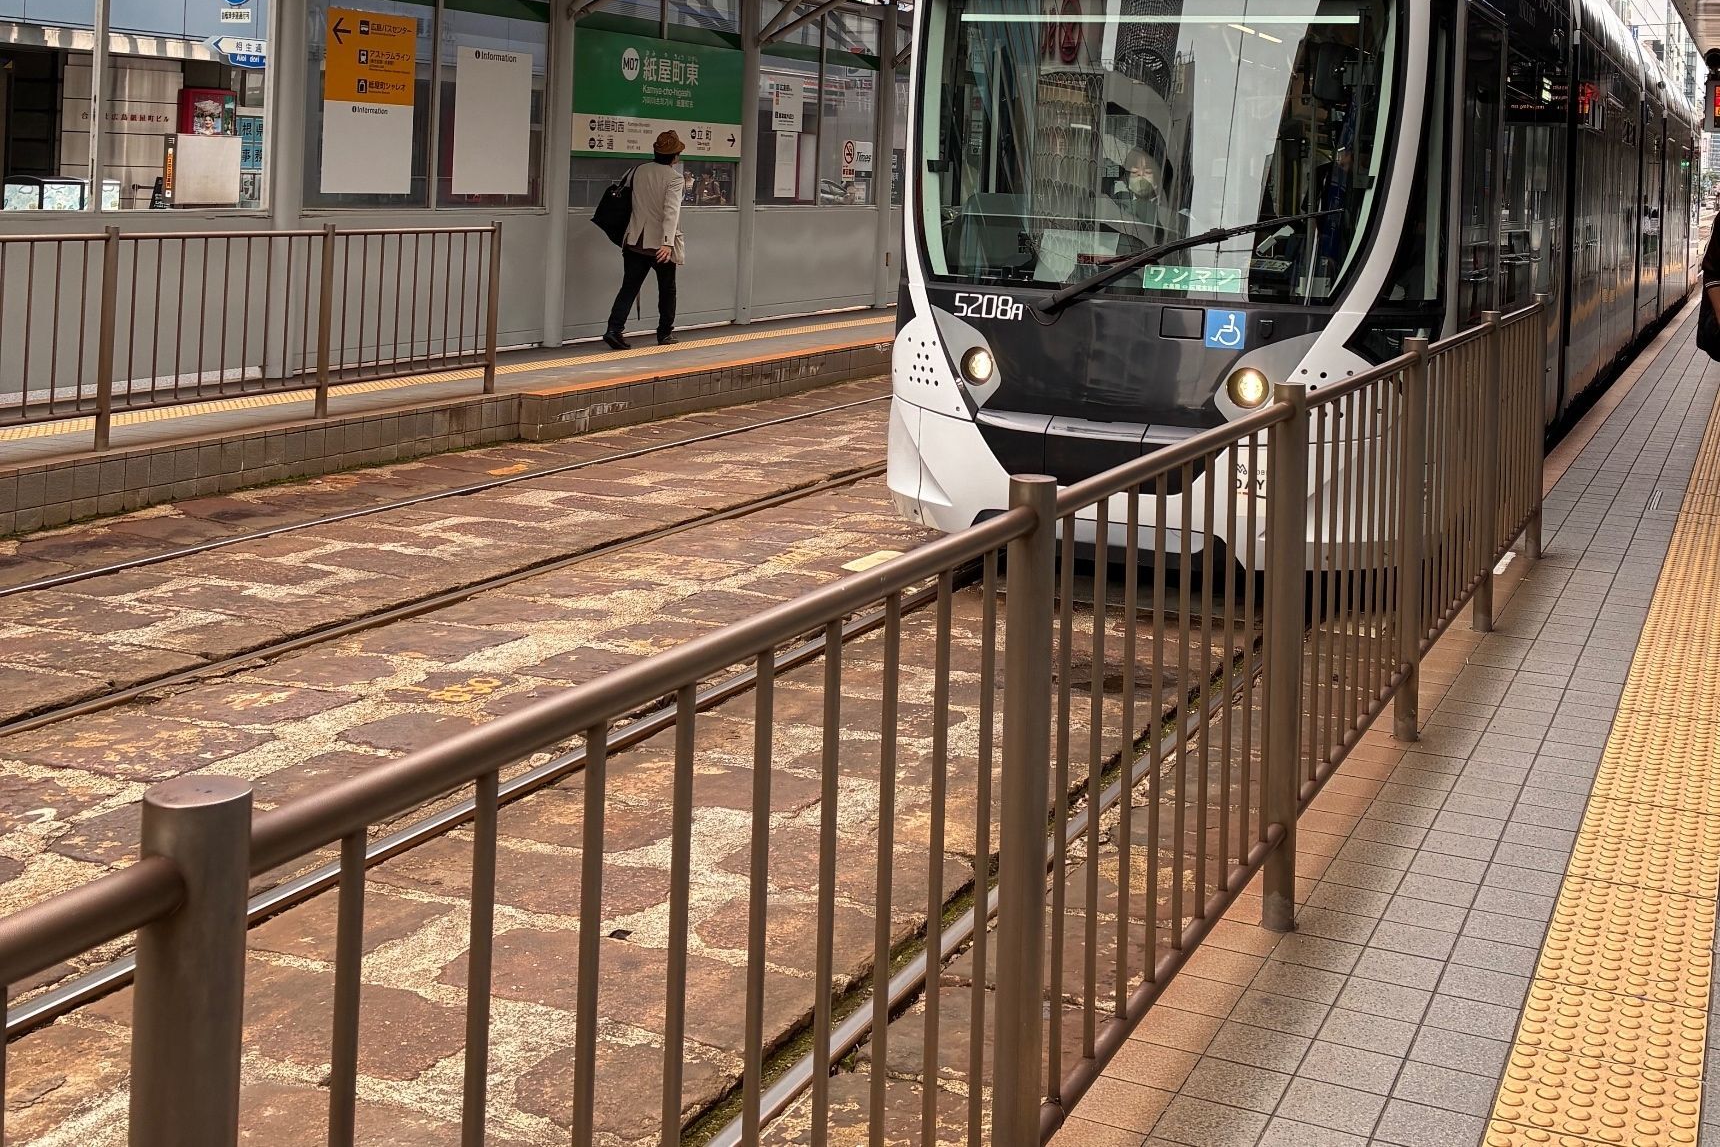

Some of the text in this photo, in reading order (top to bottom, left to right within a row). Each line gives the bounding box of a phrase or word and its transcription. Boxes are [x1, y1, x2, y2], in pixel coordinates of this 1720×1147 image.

[369, 50, 411, 61] アストラムライン
[481, 51, 517, 63] Information
[622, 57, 639, 71] M07
[643, 56, 699, 86] 紙屋町東
[357, 106, 388, 115] Information
[855, 151, 872, 163] Times
[1149, 267, 1236, 288] ワンマン
[953, 292, 1023, 321] 5208A
